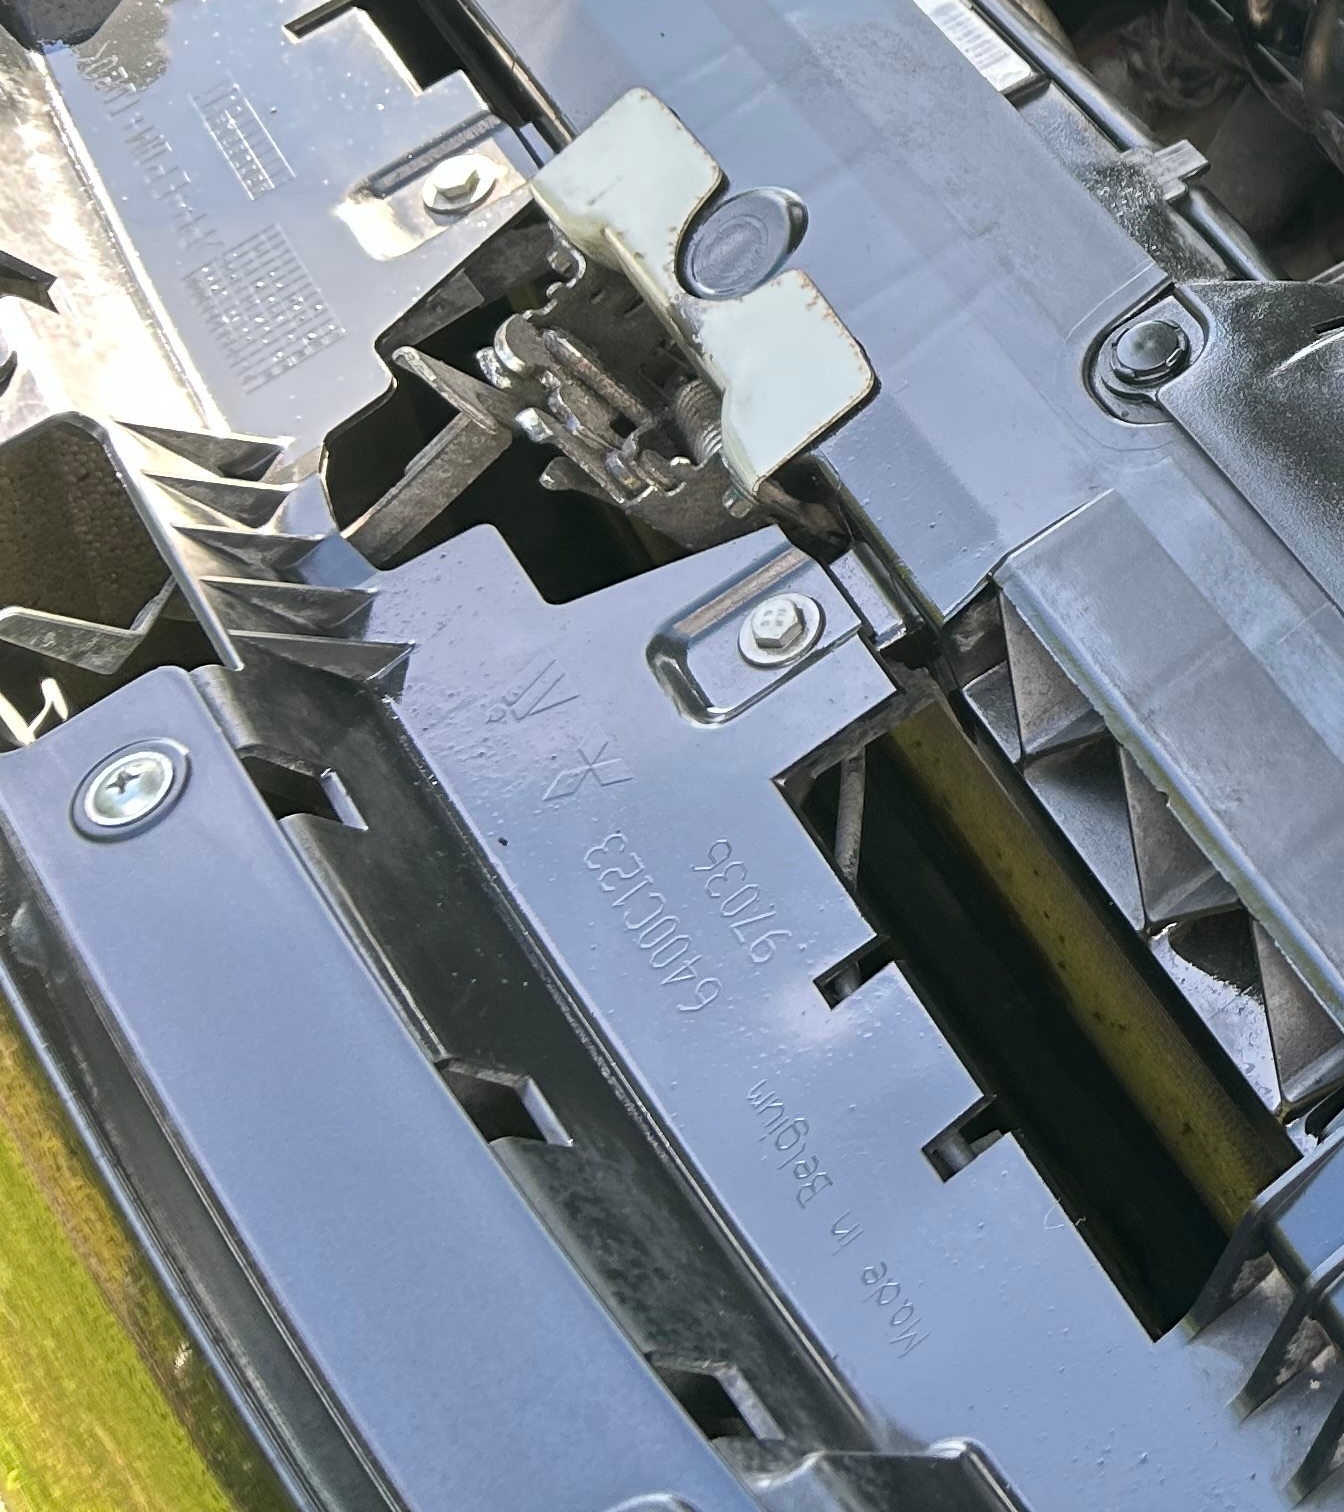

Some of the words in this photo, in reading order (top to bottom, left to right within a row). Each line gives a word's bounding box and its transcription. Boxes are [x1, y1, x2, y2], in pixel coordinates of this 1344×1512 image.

[585, 831, 722, 1014] 6400C123
[691, 837, 794, 965] 97036
[746, 1078, 835, 1209] Belgium
[861, 1261, 930, 1359] Made
